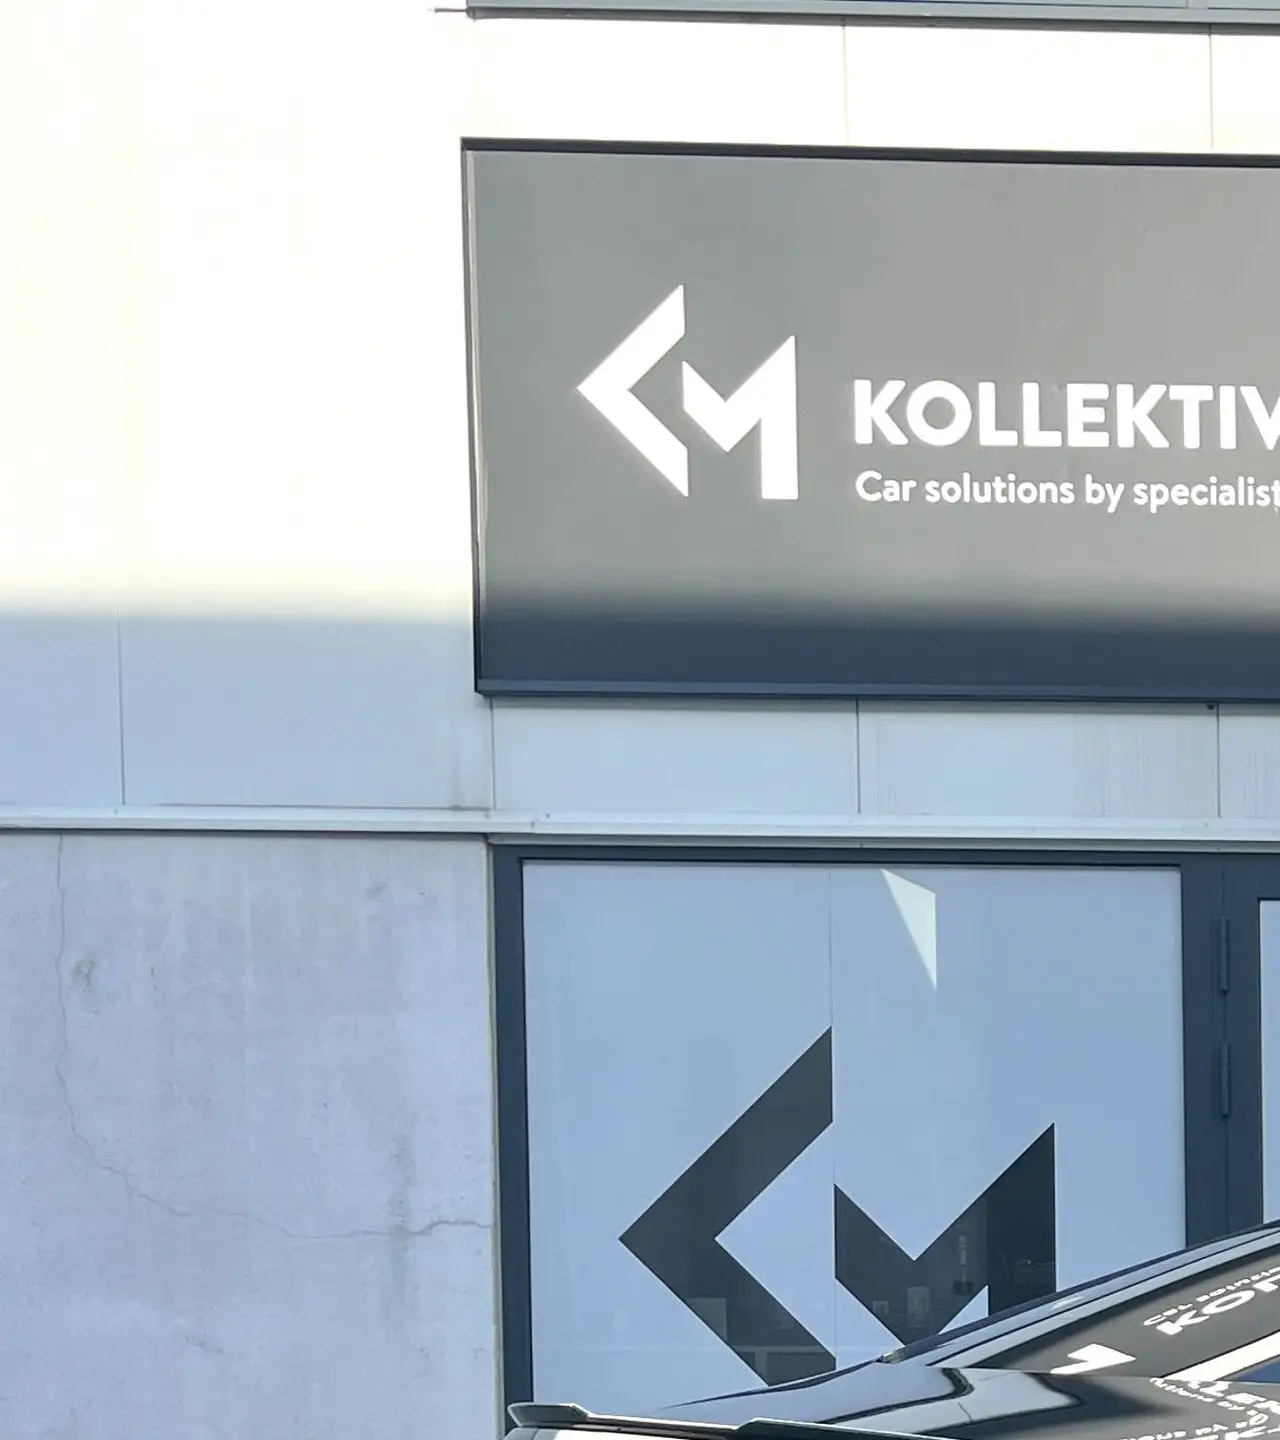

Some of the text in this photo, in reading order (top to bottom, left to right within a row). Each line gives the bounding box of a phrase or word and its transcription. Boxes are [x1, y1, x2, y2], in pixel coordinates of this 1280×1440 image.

[855, 470, 917, 503] Car
[924, 473, 1075, 505] solutions
[1085, 473, 1125, 514] by
